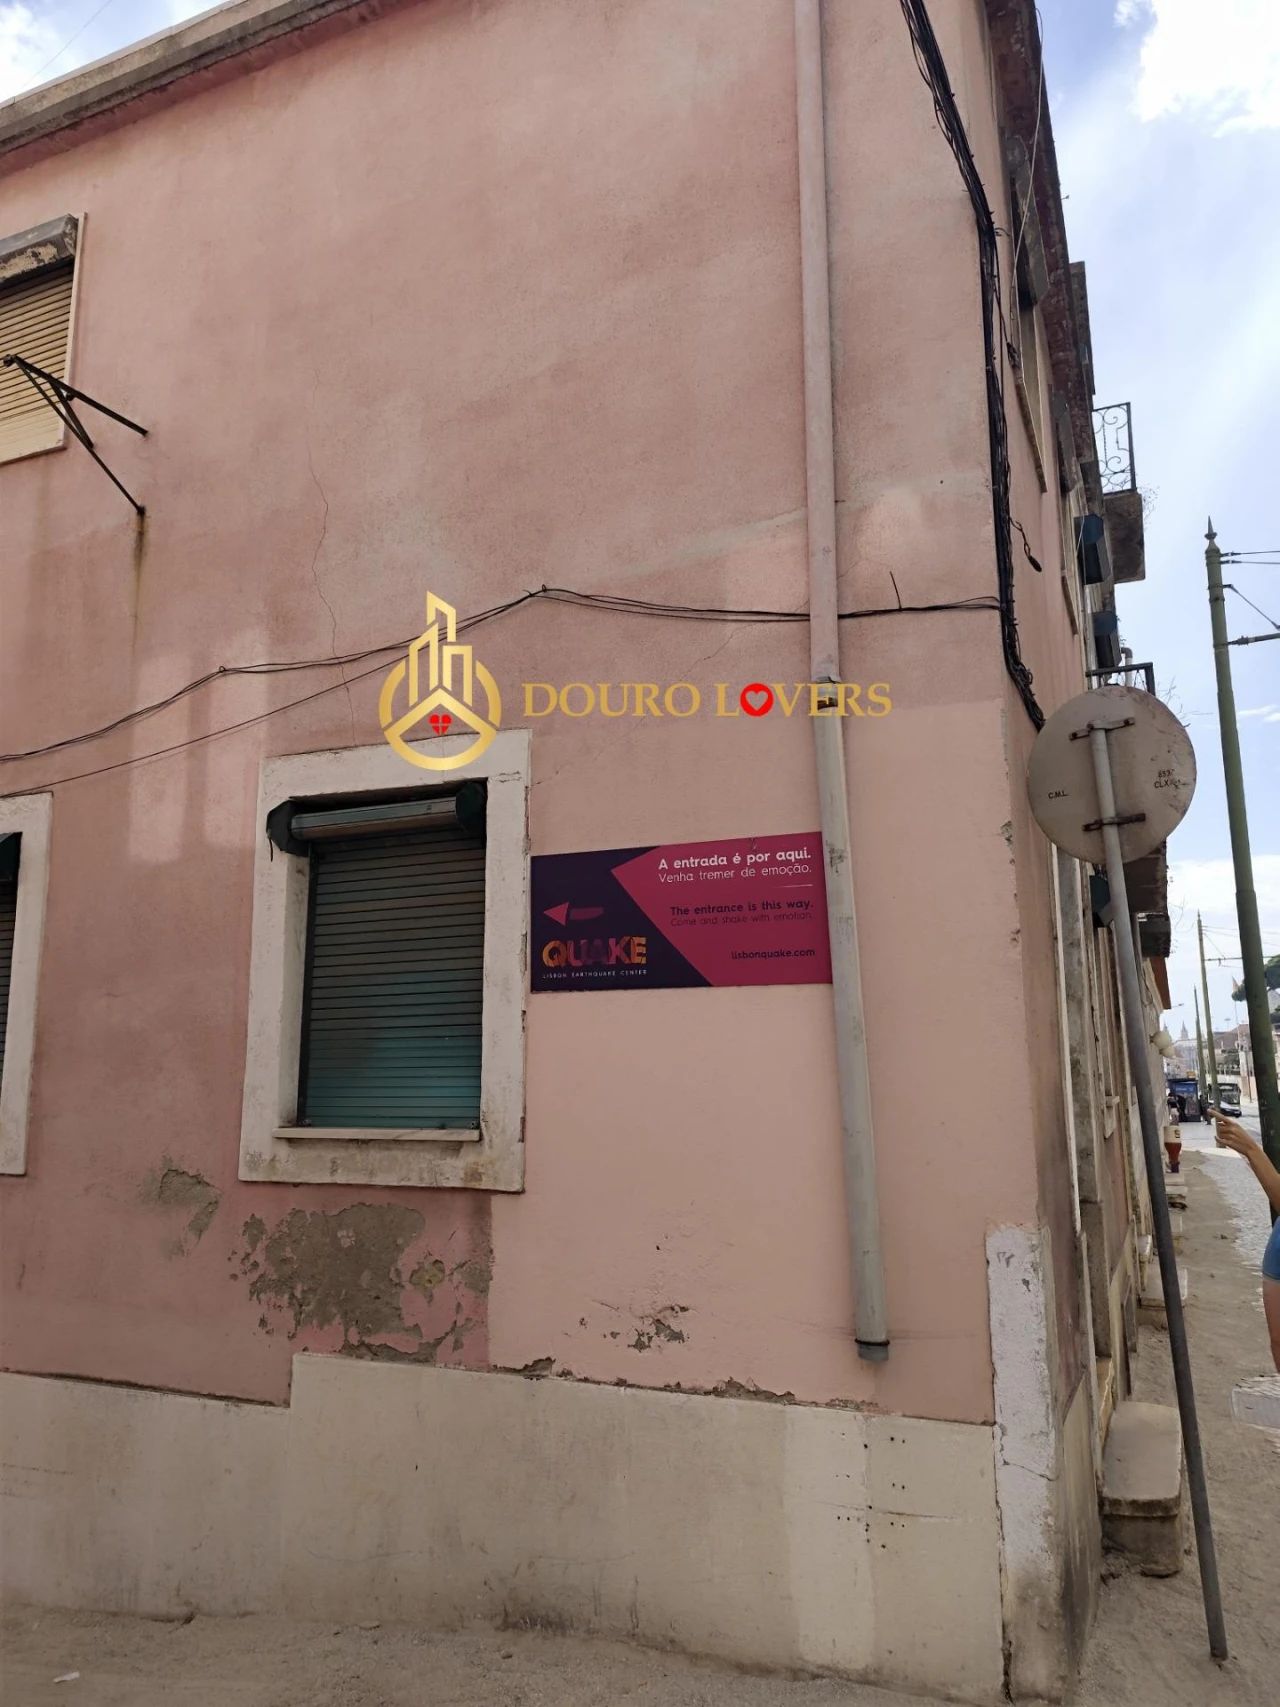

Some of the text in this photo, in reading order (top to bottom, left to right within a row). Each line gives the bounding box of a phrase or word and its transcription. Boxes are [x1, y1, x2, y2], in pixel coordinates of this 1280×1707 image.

[658, 847, 812, 870] A entrada é por aqui.
[658, 862, 812, 883] Venha tremer de emoção.
[670, 899, 814, 916] The entrance is this way.
[670, 917, 697, 927] Come
[700, 915, 718, 925] and
[722, 914, 748, 924] shake
[752, 913, 770, 922] with
[542, 936, 647, 967] QUAKE
[731, 948, 816, 960] lisbonquake.com
[572, 970, 616, 978] EARTHQUAKE
